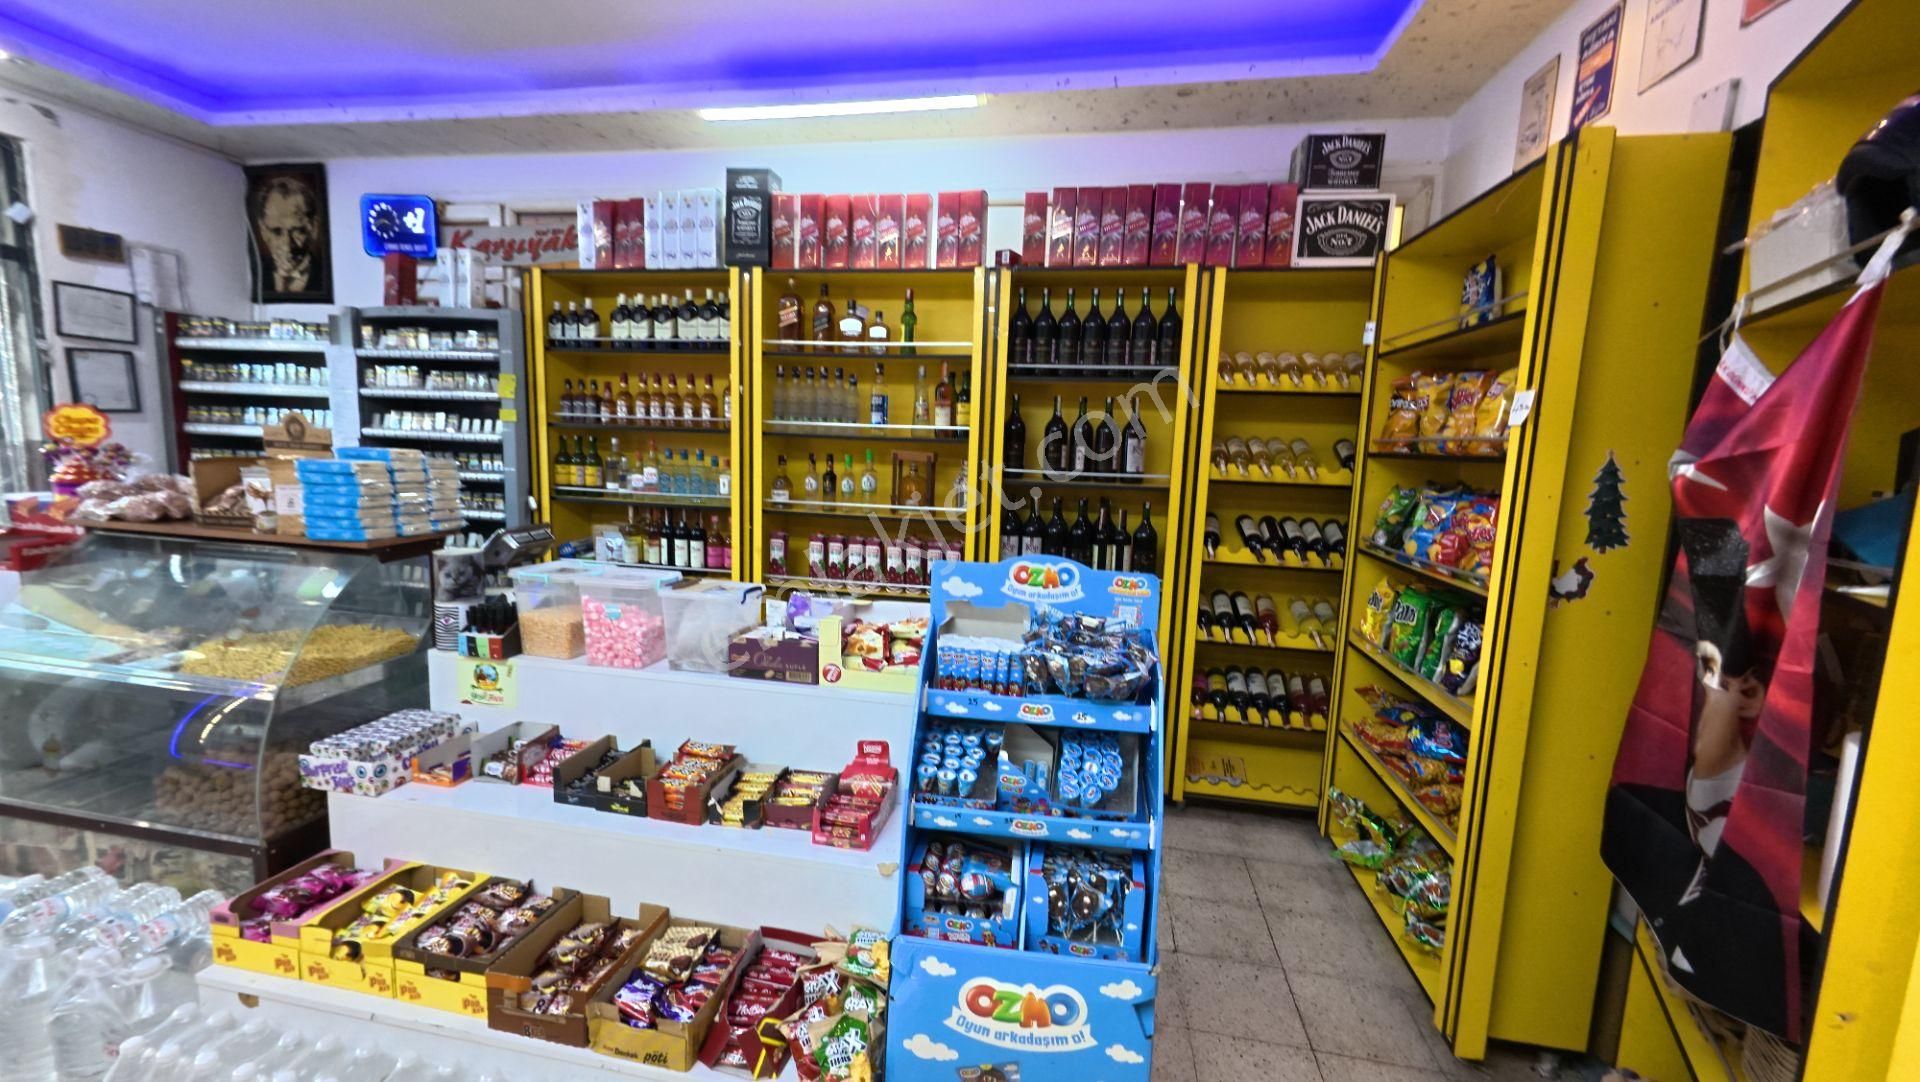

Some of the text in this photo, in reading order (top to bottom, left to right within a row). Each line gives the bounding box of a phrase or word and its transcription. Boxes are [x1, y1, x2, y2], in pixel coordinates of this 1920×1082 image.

[1306, 205, 1385, 235] JACK DANIEL'S
[1013, 564, 1076, 589] OZMO
[966, 984, 1080, 1028] OZMO
[956, 1014, 1086, 1048] Oyun arkadaşım o!
[643, 1050, 669, 1065] pöti
